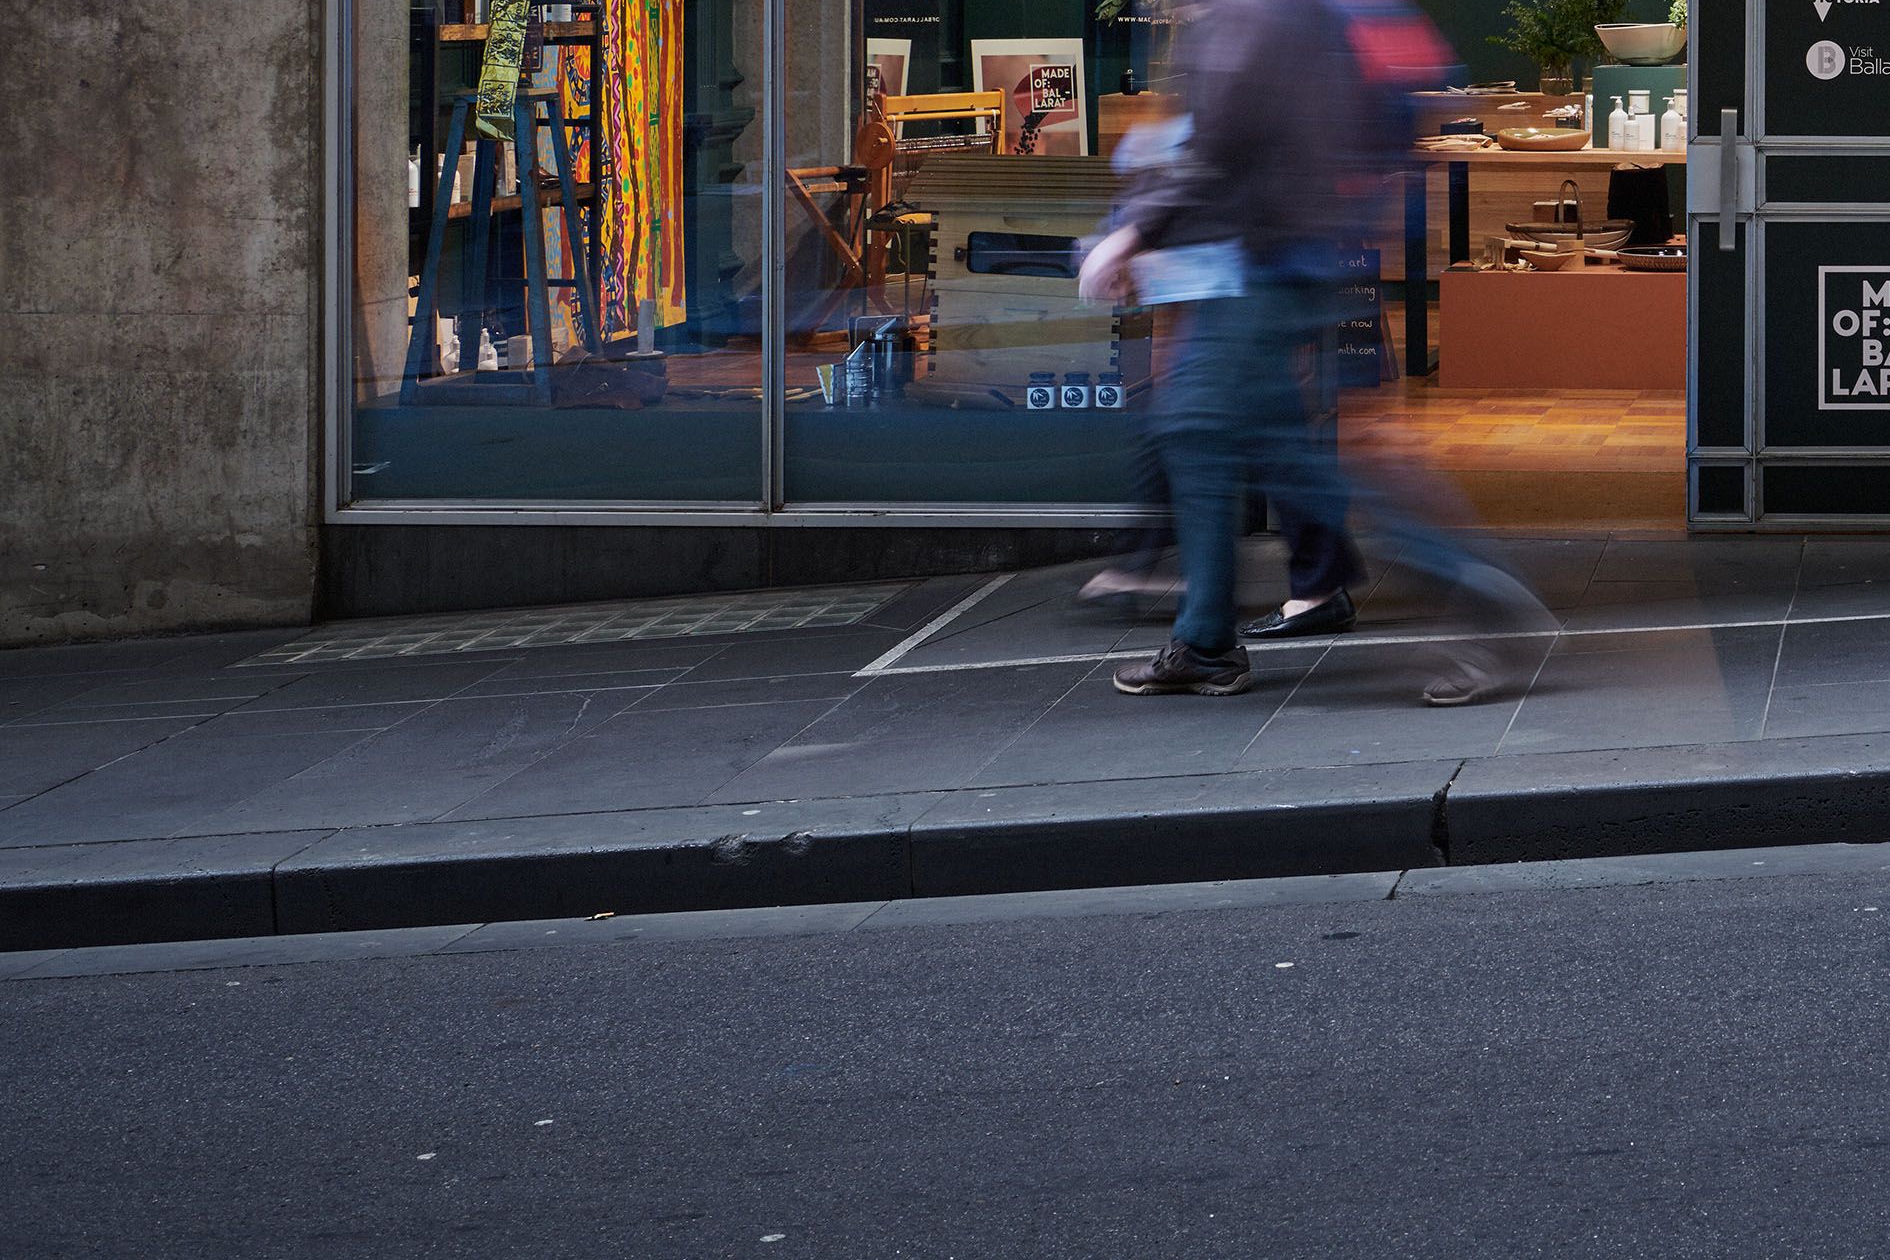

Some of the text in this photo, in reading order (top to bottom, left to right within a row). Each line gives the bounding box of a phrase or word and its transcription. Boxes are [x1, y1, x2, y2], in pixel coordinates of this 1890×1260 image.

[1849, 46, 1873, 58] Visit
[1041, 68, 1070, 79] MADE
[1034, 78, 1051, 88] OF:
[1034, 98, 1066, 108] LARAT
[1348, 254, 1367, 268] art
[1351, 320, 1373, 328] now
[1832, 309, 1890, 337] OF:
